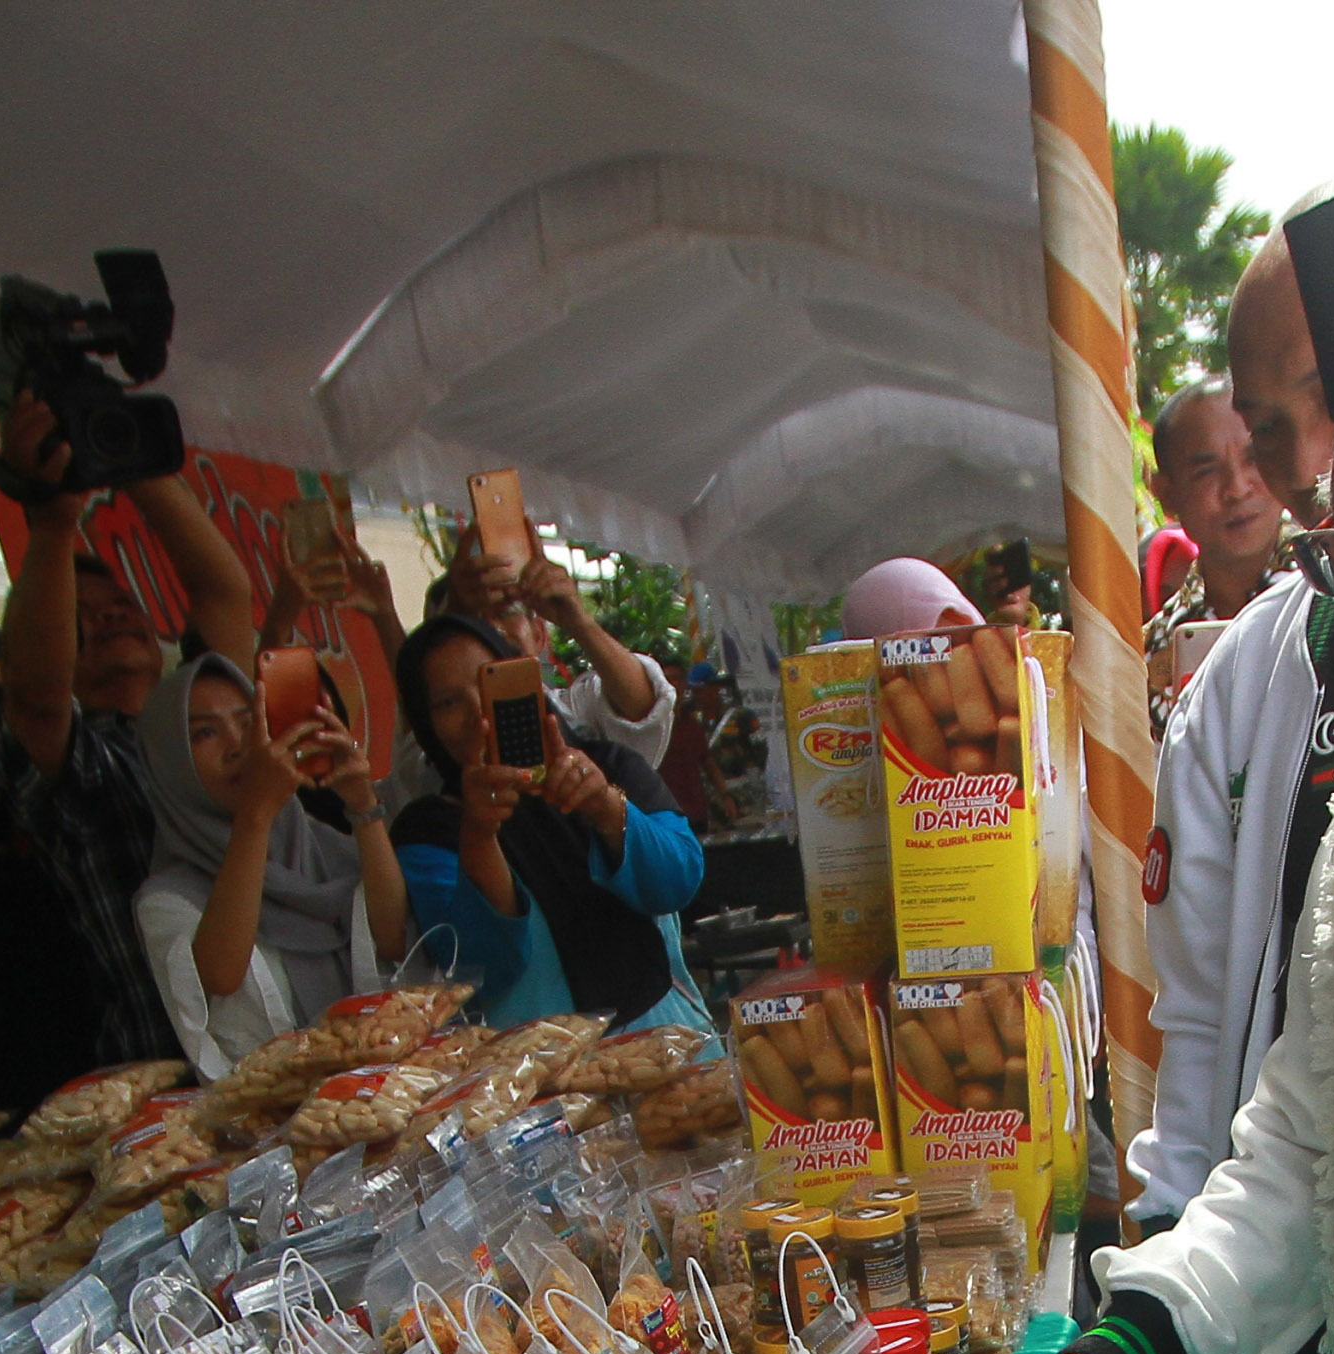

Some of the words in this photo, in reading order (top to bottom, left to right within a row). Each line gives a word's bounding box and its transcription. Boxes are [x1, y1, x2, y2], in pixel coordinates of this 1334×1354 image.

[882, 653, 951, 667] INDONESIA
[897, 772, 1017, 807] Amplang
[914, 805, 1010, 831] IDAMAN
[763, 1118, 874, 1152] Amplang
[910, 1108, 1024, 1141] Amplang
[925, 1140, 1015, 1163] IDAMAN
